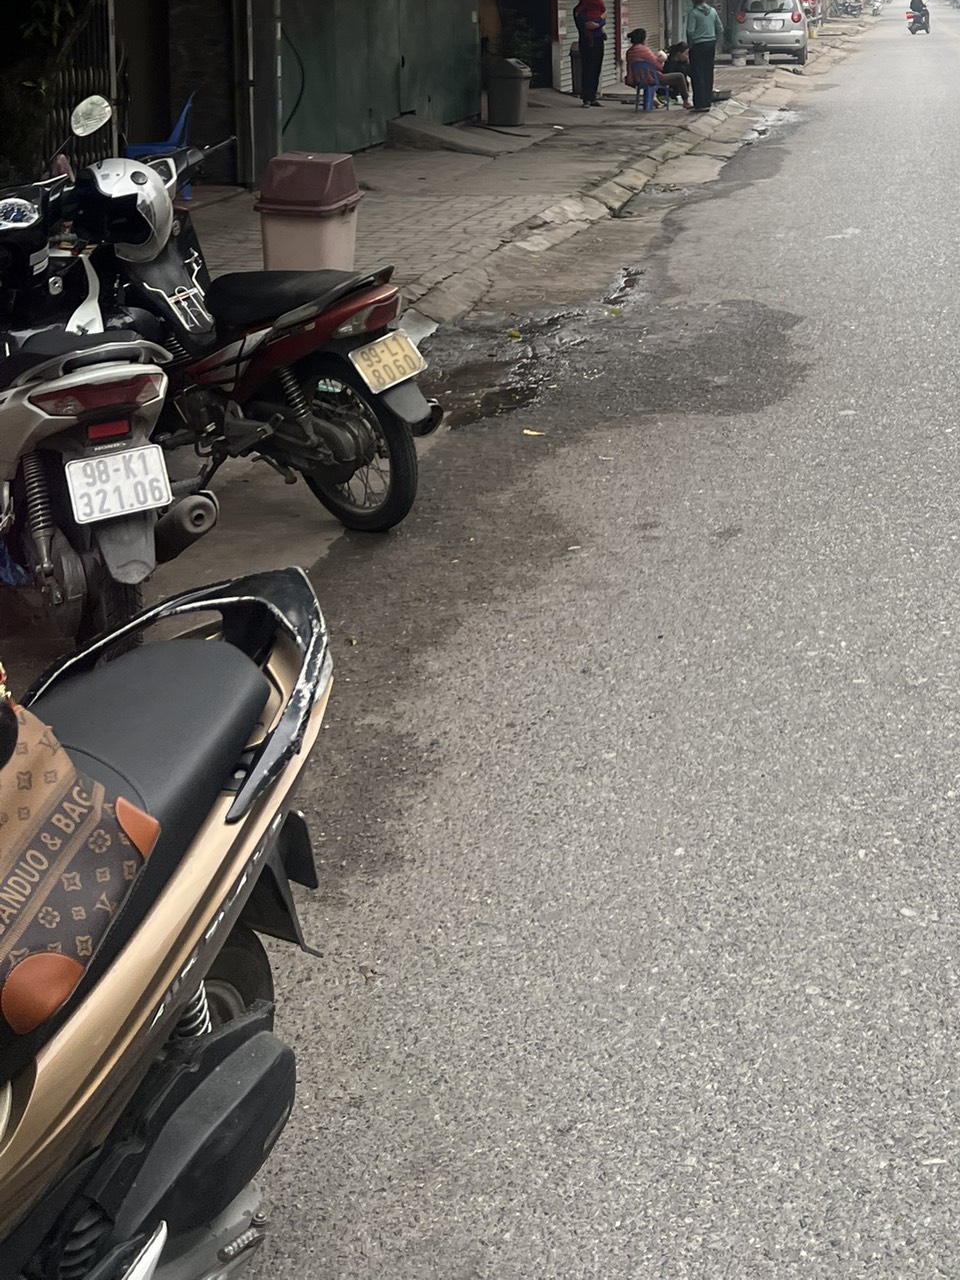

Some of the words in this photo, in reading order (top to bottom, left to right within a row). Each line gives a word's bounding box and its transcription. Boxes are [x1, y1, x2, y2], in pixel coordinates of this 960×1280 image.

[360, 335, 405, 368] 99-L1
[372, 354, 417, 386] 8060
[82, 451, 149, 487] 98-K1
[79, 477, 164, 518] 321.06
[0, 849, 49, 935] ANDUO
[41, 832, 61, 851] &
